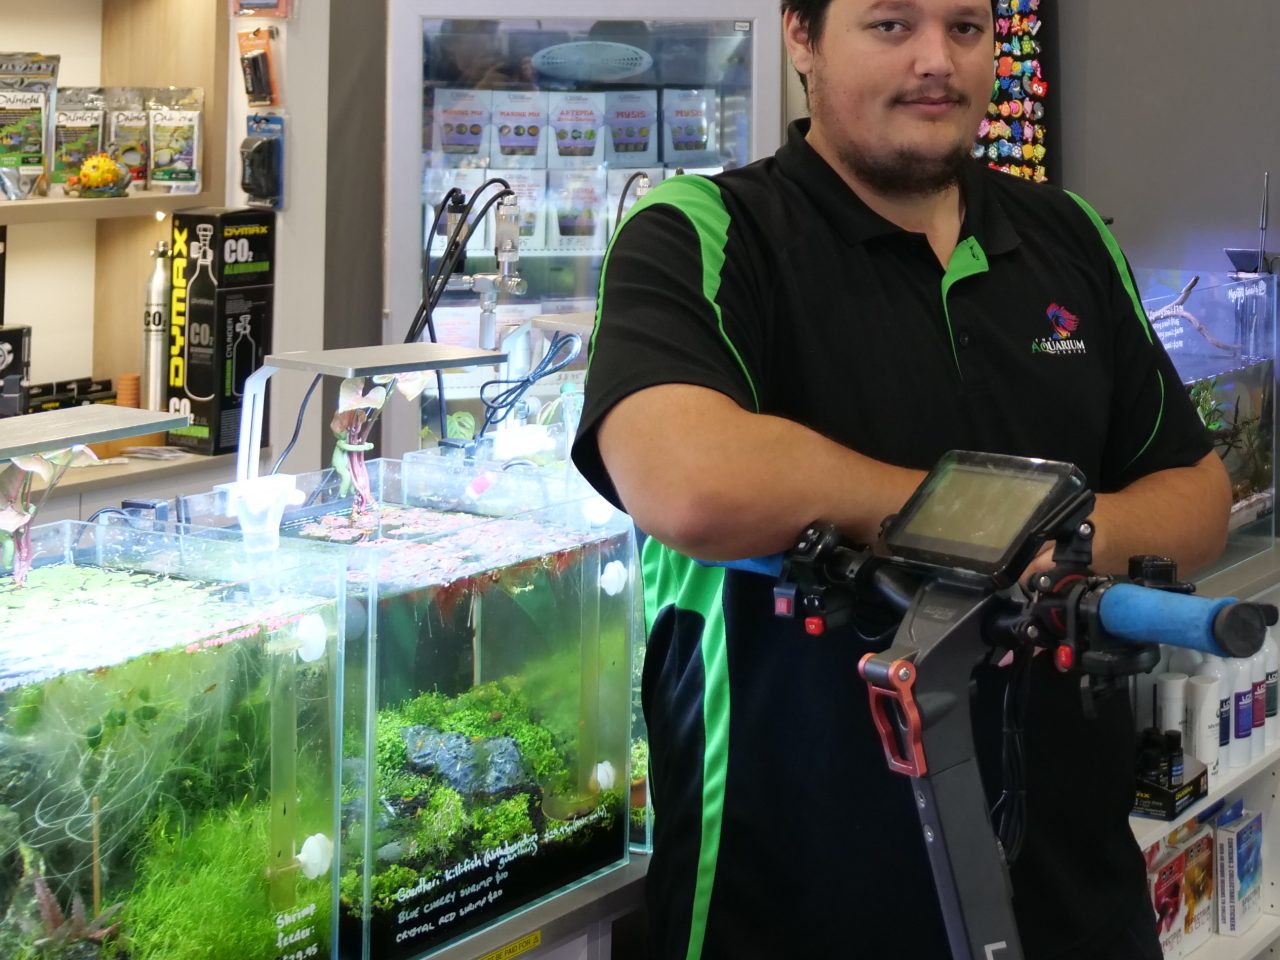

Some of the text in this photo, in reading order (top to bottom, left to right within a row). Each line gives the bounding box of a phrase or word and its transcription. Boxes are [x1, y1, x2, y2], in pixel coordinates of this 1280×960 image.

[224, 225, 268, 237] DYMAX
[169, 227, 188, 388] DYMAX
[1031, 339, 1086, 354] AQUARIUM
[397, 908, 420, 924] BLUE
